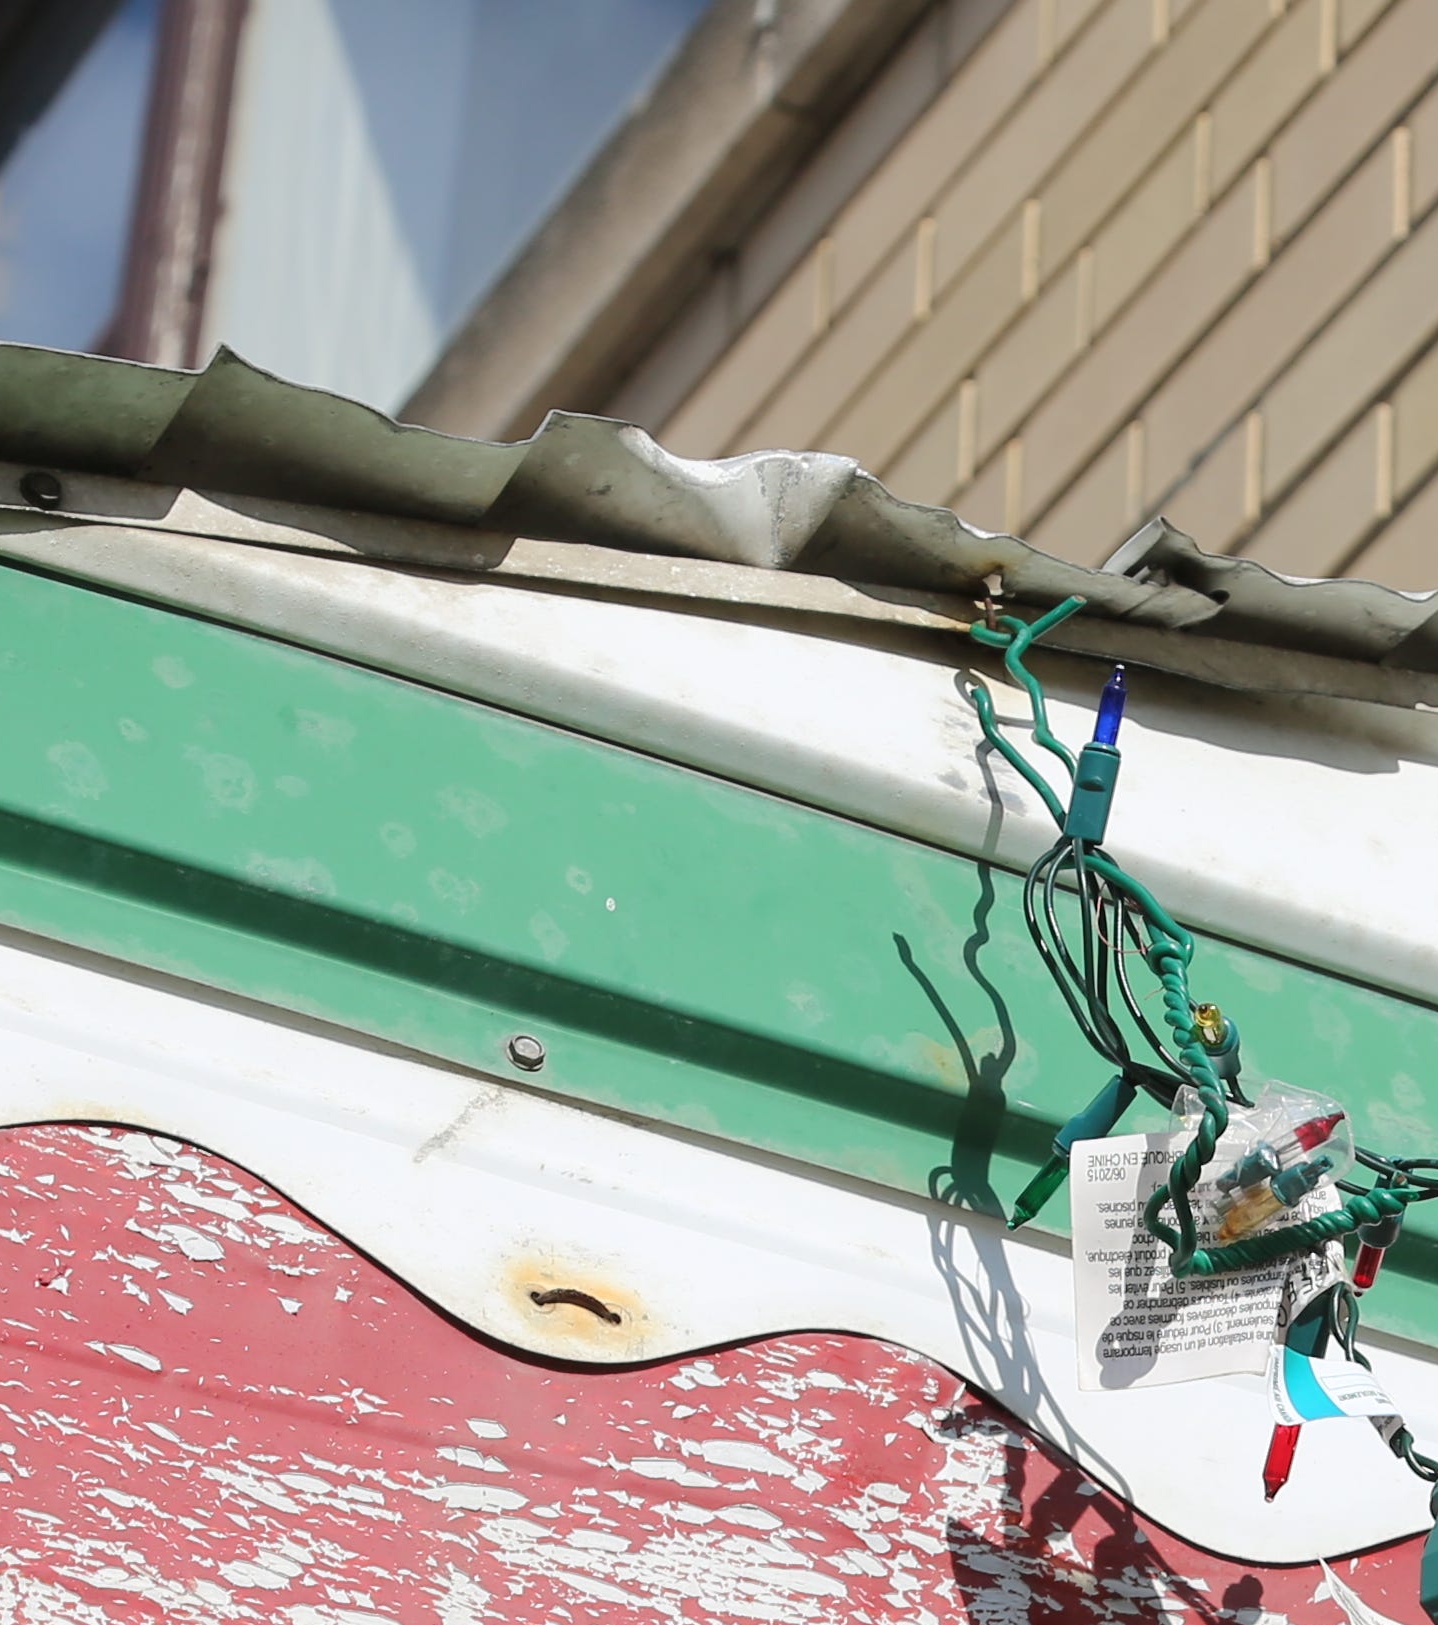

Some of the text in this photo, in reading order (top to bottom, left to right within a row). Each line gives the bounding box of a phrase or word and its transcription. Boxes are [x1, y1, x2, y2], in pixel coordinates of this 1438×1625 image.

[1087, 1154, 1121, 1167] CHINE
[1123, 1152, 1138, 1165] EN
[1087, 1167, 1126, 1181] 06/2015
[1095, 1199, 1136, 1215] piscines.
[1104, 1214, 1136, 1228] jeunes
[1085, 1247, 1166, 1265] produit électrique,
[1108, 1267, 1122, 1279] les
[1125, 1263, 1142, 1277] que
[1108, 1284, 1122, 1296] les
[1152, 1283, 1173, 1295] Pour
[1175, 1281, 1186, 1295] 5)
[1189, 1280, 1226, 1294] fusibles.
[1226, 1278, 1239, 1288] ou
[1125, 1284, 1149, 1297] éviter
[1123, 1299, 1134, 1310] ce
[1136, 1298, 1190, 1312] débrancher
[1186, 1305, 1237, 1322] décoratives
[1109, 1317, 1122, 1327] ce
[1123, 1316, 1146, 1327] avec
[1213, 1320, 1223, 1334] 3)
[1116, 1329, 1144, 1343] risque
[1145, 1331, 1155, 1343] le
[1156, 1327, 1188, 1341] réduire
[1189, 1324, 1212, 1337] Pour
[1101, 1332, 1114, 1345] de
[1154, 1337, 1182, 1352] usage
[1184, 1339, 1195, 1350] un
[1208, 1331, 1254, 1347] installation
[1102, 1342, 1152, 1359] temporaire
